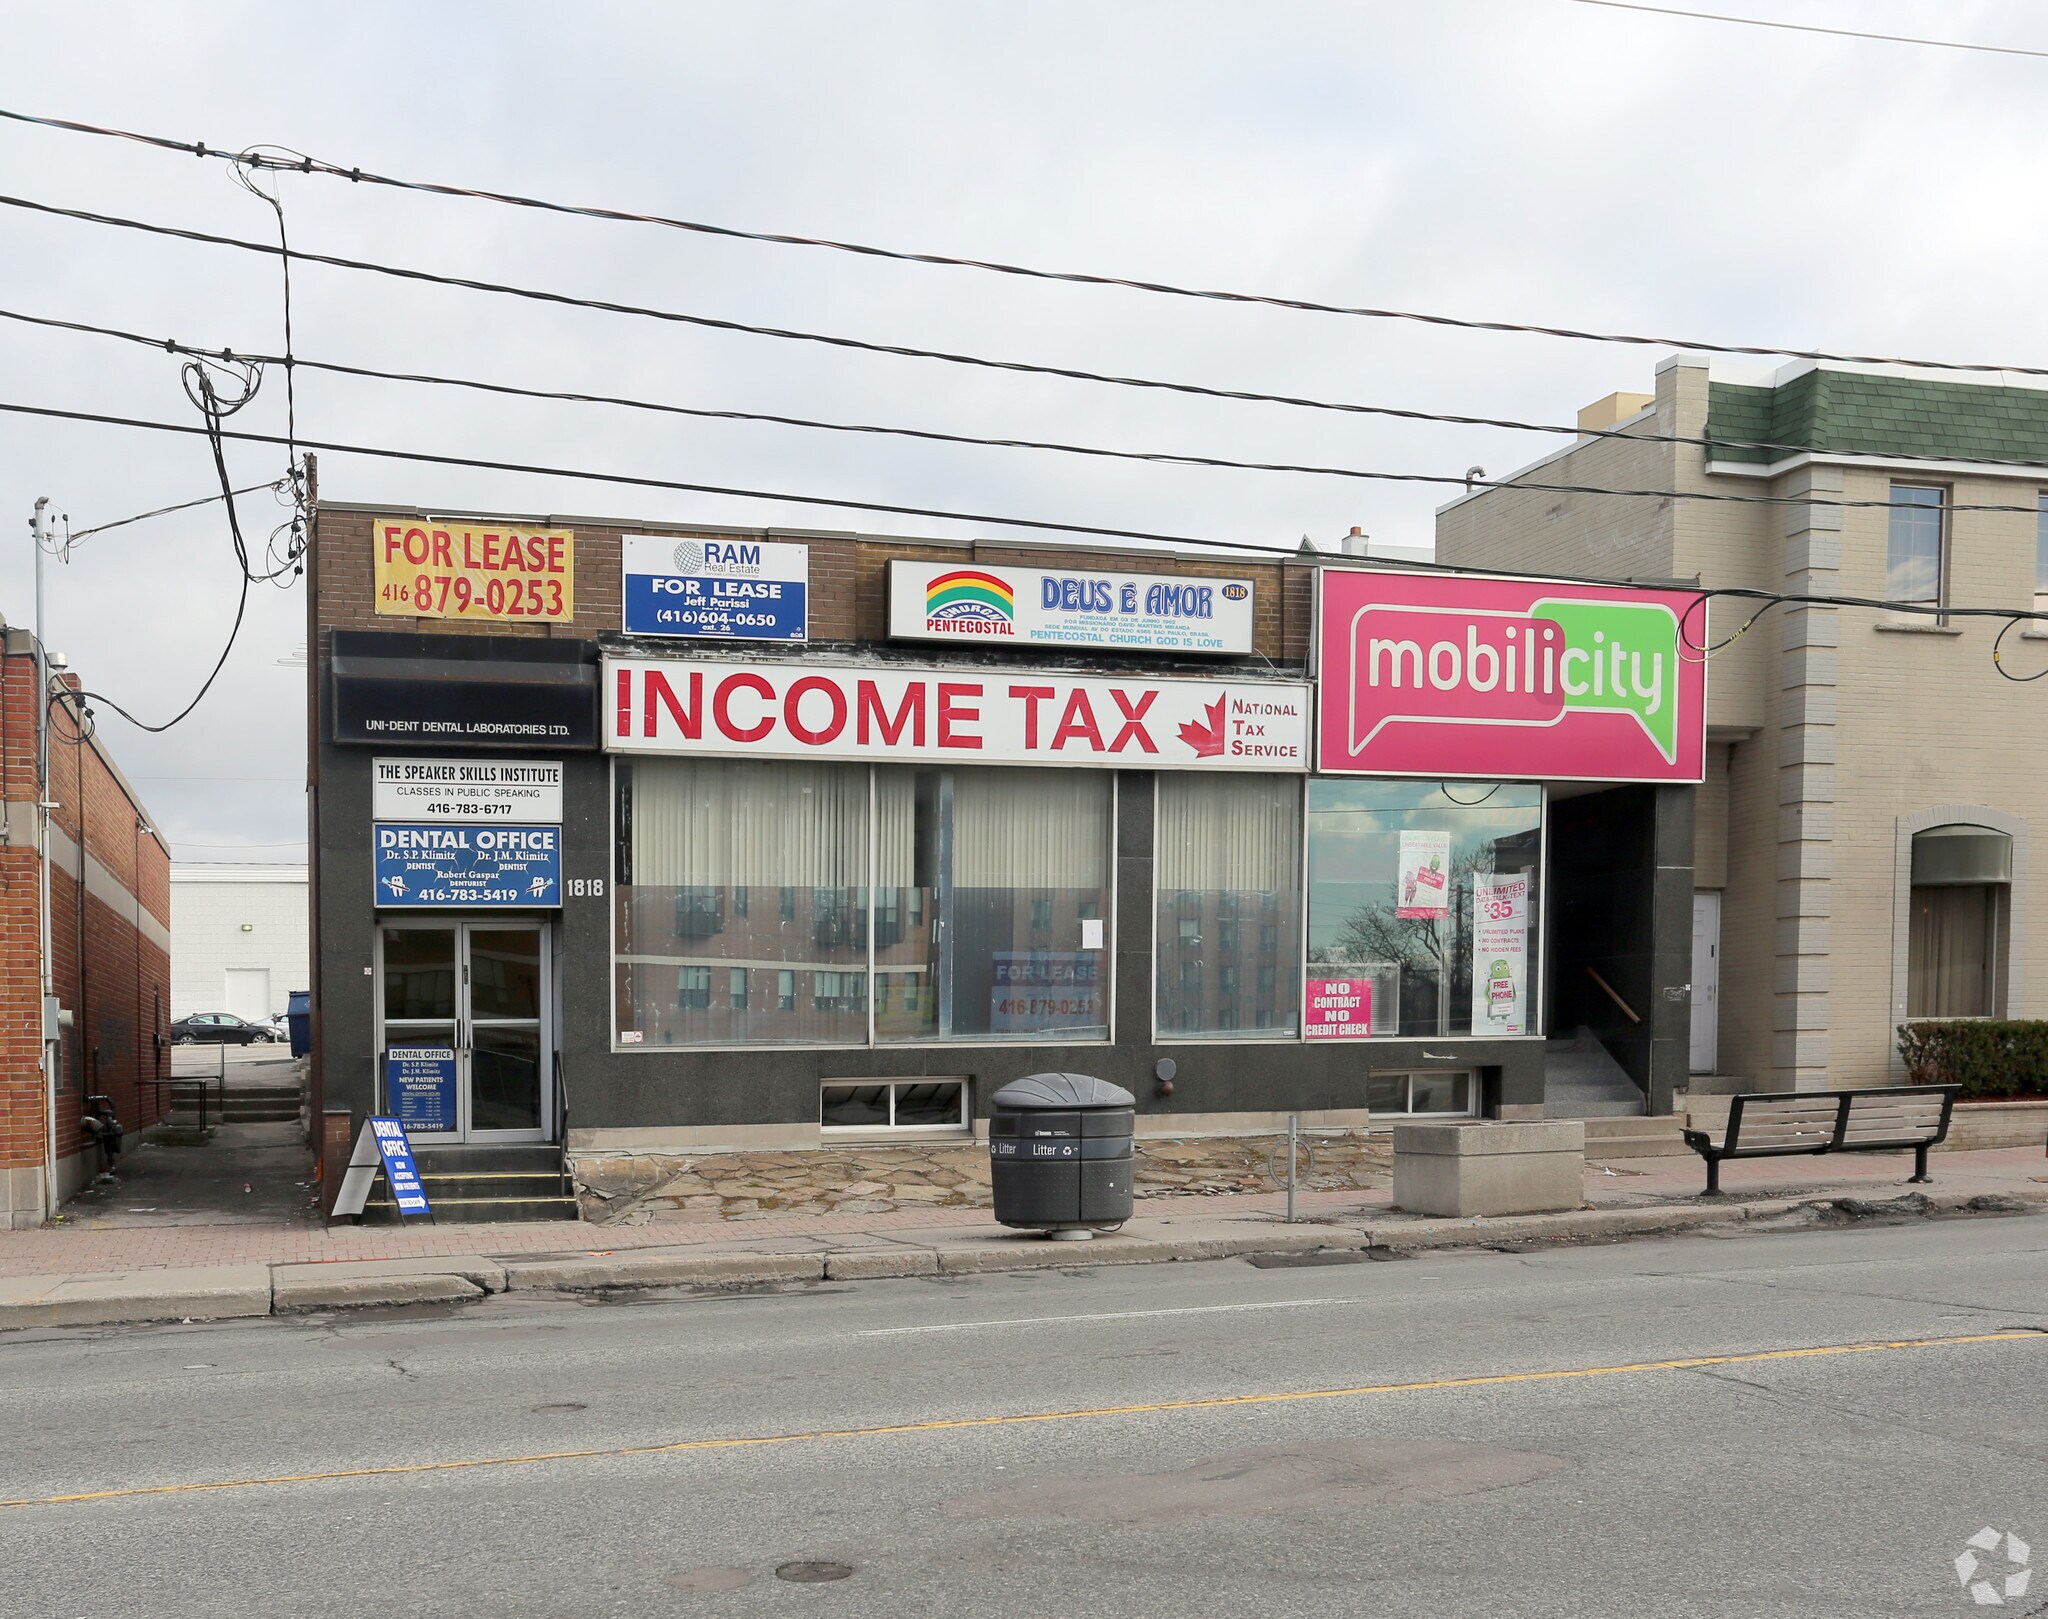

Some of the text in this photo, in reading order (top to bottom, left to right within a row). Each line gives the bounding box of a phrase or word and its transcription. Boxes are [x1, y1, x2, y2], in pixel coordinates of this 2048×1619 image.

[384, 526, 564, 573] FOR LEASE
[704, 542, 760, 565] RAM
[704, 562, 760, 574] Real Estate
[382, 574, 562, 616] 416 879-0253
[652, 578, 782, 598] FOR LEASE
[1224, 586, 1246, 598] 1818
[684, 596, 750, 608] Jeff Parissi
[1041, 576, 1214, 619] DEUS É AMOR
[656, 609, 776, 626] (416)604-0650
[939, 604, 1003, 620] CHURCH
[926, 619, 1014, 635] PENTECOSTAL
[1030, 630, 1223, 648] PENTECOSTAL CHURCH GOD IS LOVE
[1368, 624, 1662, 716] mobilicity
[616, 669, 1160, 754] INCOME TAX
[1232, 698, 1298, 716] NATIONAL
[366, 720, 570, 736] UNI-DENT DENTAL LABORATORIES LTD.
[1232, 720, 1265, 736] TAX
[1232, 740, 1298, 758] SERVICE
[379, 765, 558, 782] THE SPEAKER SKILLS INSTITUTE
[397, 787, 540, 798] CLASSES IN PUBLIC SPEAKING
[427, 804, 512, 815] 416-783-6717
[380, 830, 554, 850] DENTAL OFFICE
[387, 850, 456, 860] Dr. S.P. Klimitz
[477, 850, 548, 862] Dr. J.M. Klimitz
[437, 870, 500, 880] Robert Gaspar
[419, 889, 518, 900] 416-783-5419
[568, 879, 604, 896] 1818
[1476, 882, 1526, 897] UNLIMITED
[1510, 891, 1526, 899] TEXT
[1484, 900, 1513, 920] $35
[996, 965, 1098, 980] FOR LEASE
[1326, 982, 1350, 994] NO
[1494, 980, 1508, 989] FREE
[1314, 996, 1361, 1008] CONTRACT
[1492, 990, 1512, 1000] PHONE
[1325, 1010, 1350, 1022] NO
[1306, 1024, 1368, 1036] CREDIT CHECK
[373, 1121, 404, 1138] DENTAL
[382, 1140, 408, 1156] OFFICE
[1000, 1143, 1016, 1154] Litter
[1033, 1144, 1056, 1156] Litter
